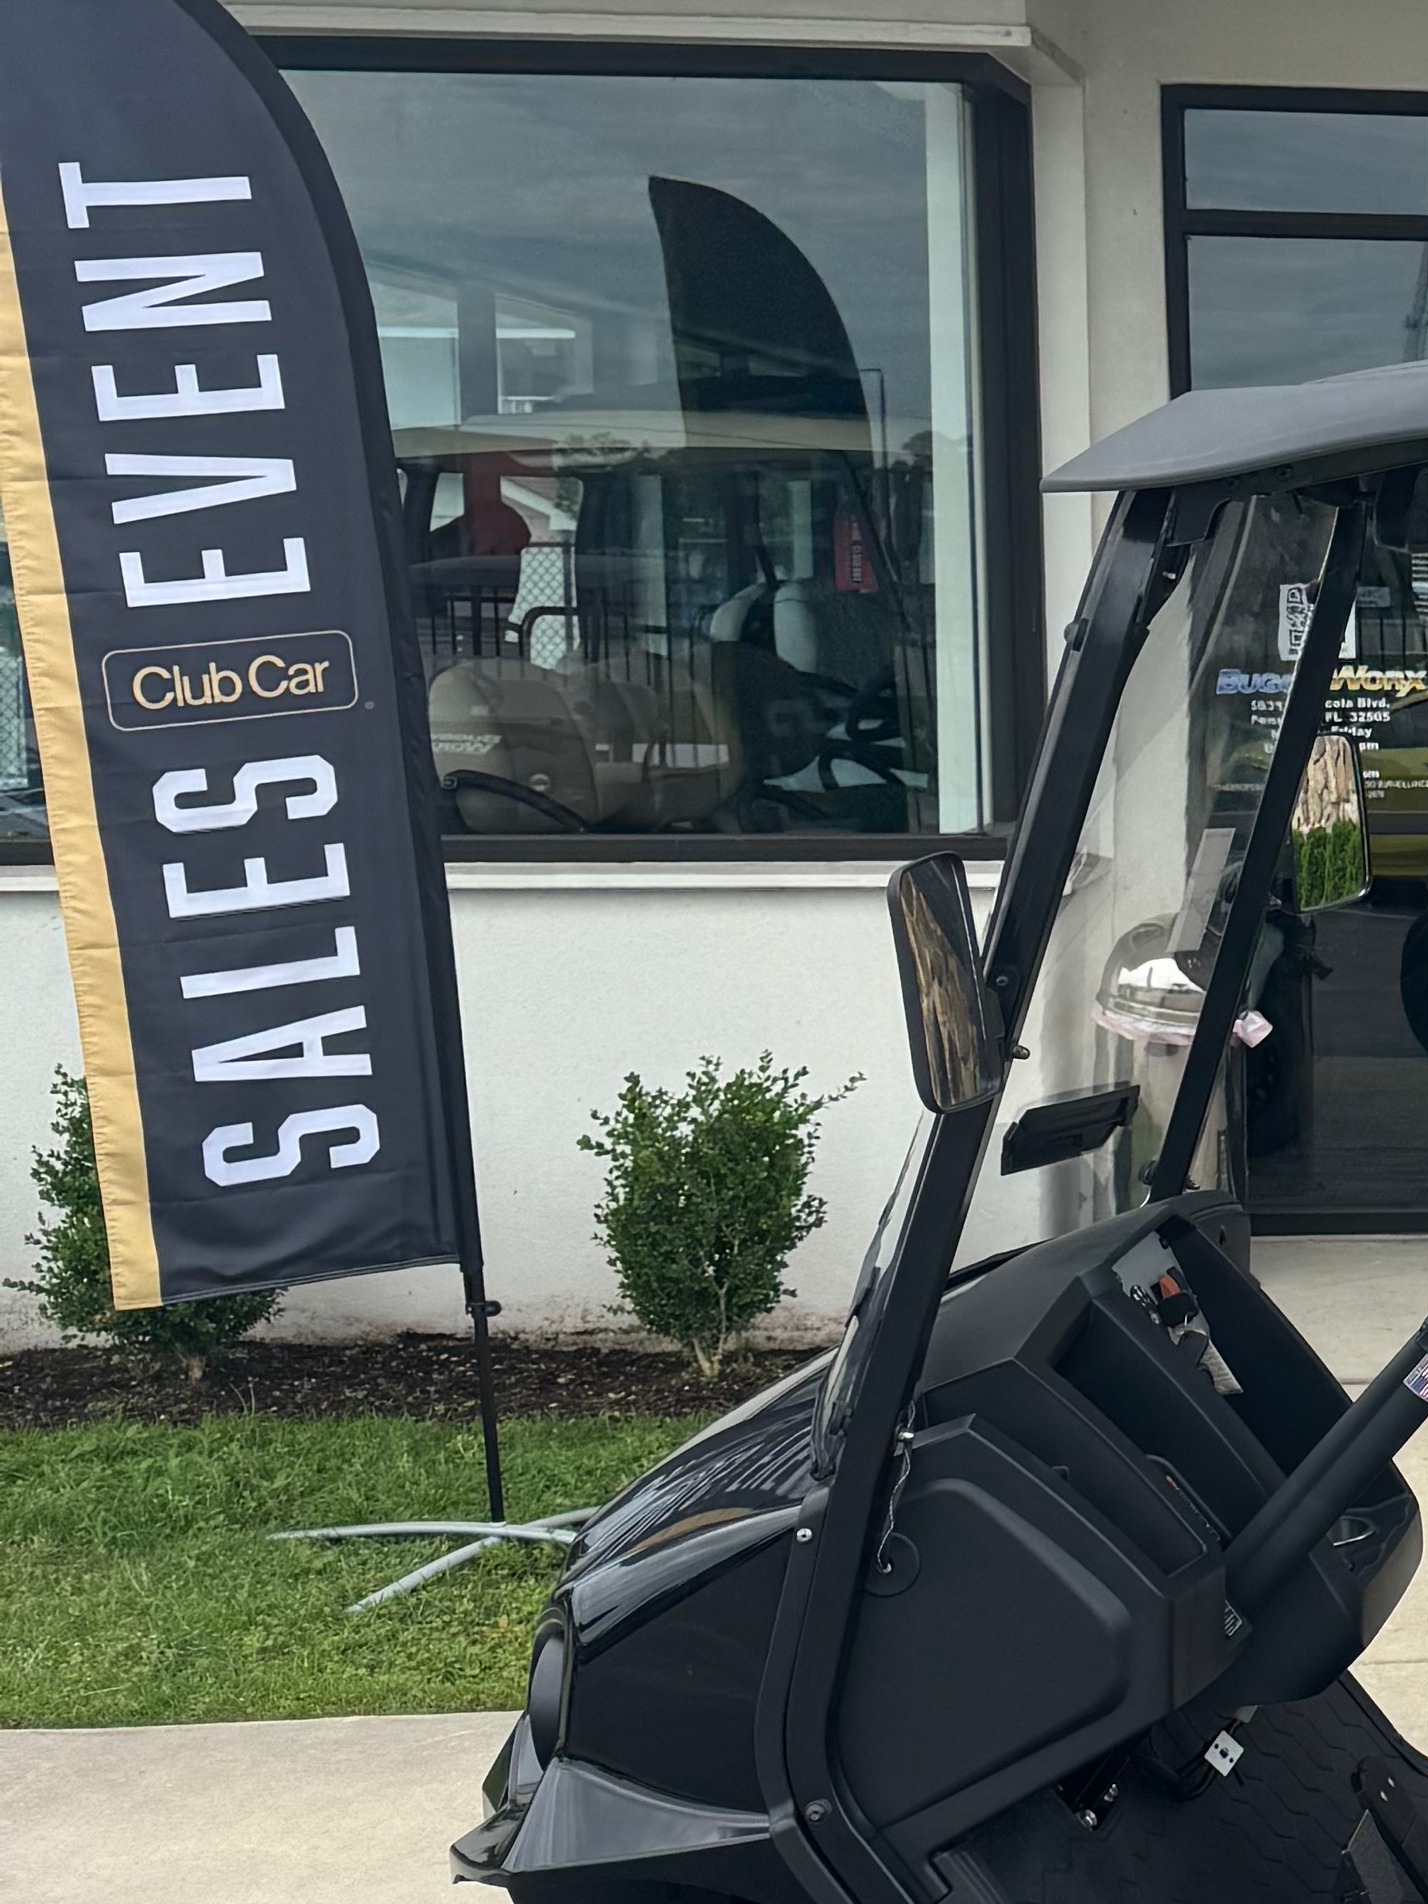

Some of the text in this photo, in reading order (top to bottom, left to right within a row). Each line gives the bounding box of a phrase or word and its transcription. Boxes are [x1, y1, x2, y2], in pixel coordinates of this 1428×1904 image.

[58, 161, 311, 607] EVENT
[132, 653, 330, 711] Club Car
[1357, 697, 1391, 709] Blvd.
[1349, 711, 1391, 723] 32505
[150, 754, 380, 1188] SALES
